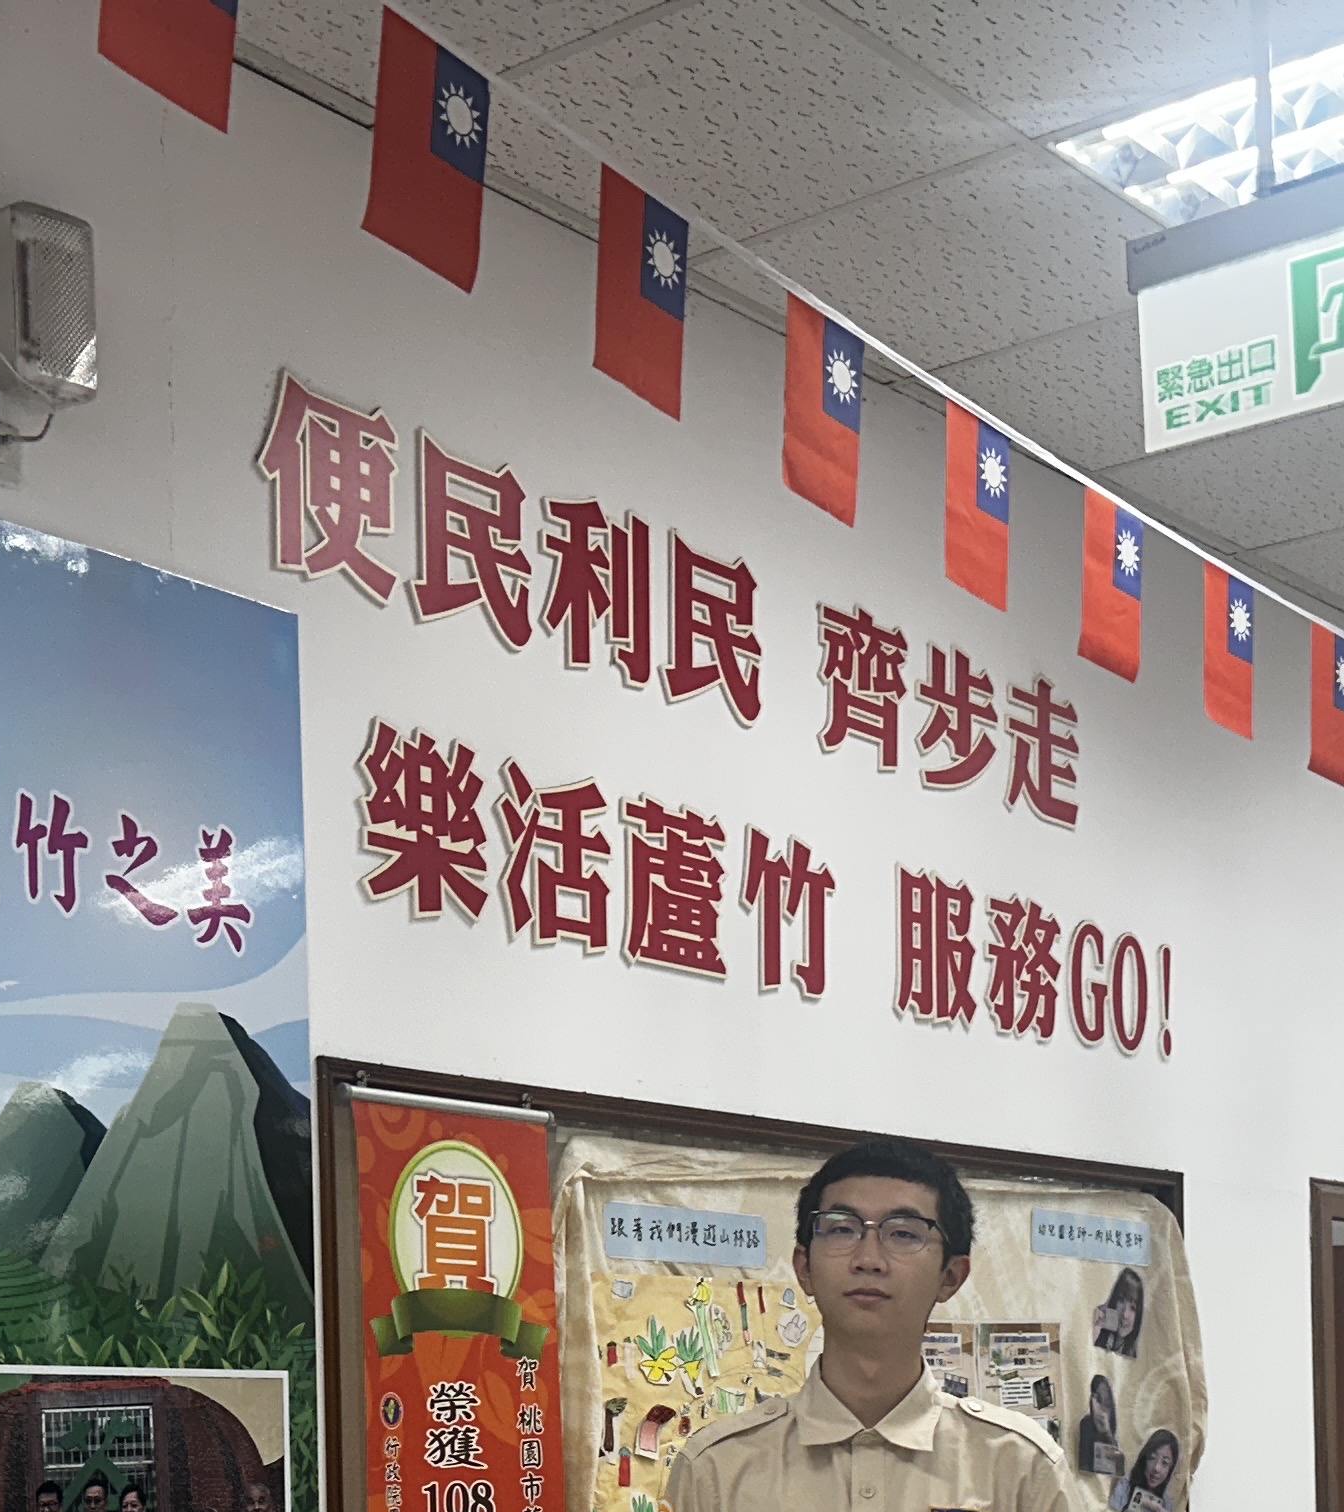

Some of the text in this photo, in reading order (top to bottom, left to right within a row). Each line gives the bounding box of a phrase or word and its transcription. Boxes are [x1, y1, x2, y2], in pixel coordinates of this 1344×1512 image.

[1155, 336, 1277, 403] 緊急出口
[1165, 382, 1273, 430] EXIT
[258, 370, 1080, 828] 便民利民 齊步走
[360, 718, 1174, 1058] 樂活蘆竹 服務GO!
[413, 1172, 499, 1296] 賀
[516, 1356, 538, 1392] 賀
